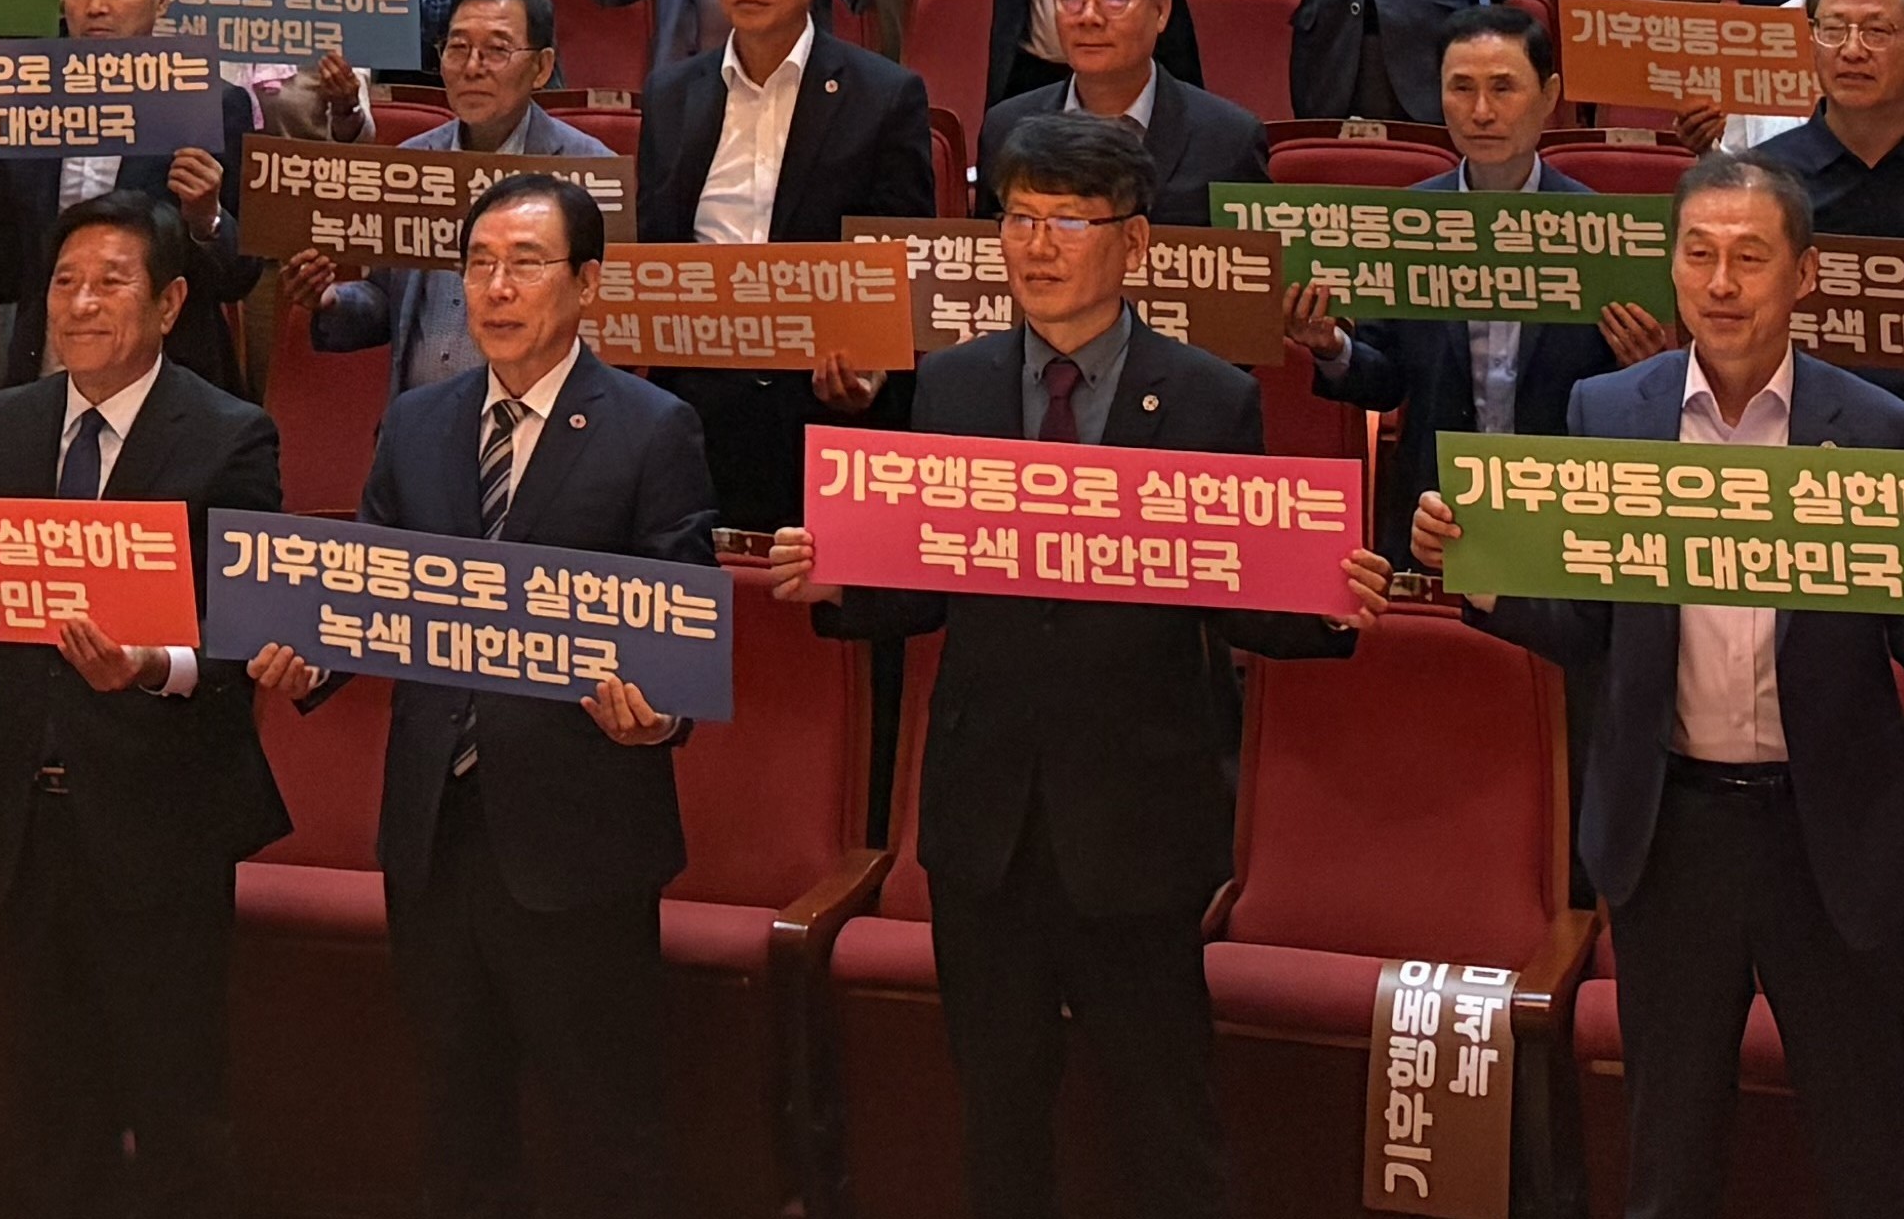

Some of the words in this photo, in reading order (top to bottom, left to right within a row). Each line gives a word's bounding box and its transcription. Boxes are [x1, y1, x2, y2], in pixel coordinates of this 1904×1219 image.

[62, 52, 209, 92] 실현하는
[1491, 210, 1666, 256] 실현하는
[1408, 265, 1581, 310] 대한민국
[820, 449, 1120, 517] 기후행동으로
[1137, 471, 1346, 531] 실현하는
[1454, 457, 1773, 520] 기후행동으로
[223, 532, 508, 610] 기후행동으로
[524, 566, 717, 638] 실현하는
[919, 523, 1019, 578] 녹색
[1036, 532, 1241, 591] 대한민국
[1563, 530, 1669, 586] 녹색
[1685, 536, 1902, 597] 대한민국
[319, 604, 411, 664] 녹색
[427, 621, 621, 684] 대한민국
[1383, 960, 1449, 1198] 기후행동으
[1448, 993, 1503, 1097] 녹색
